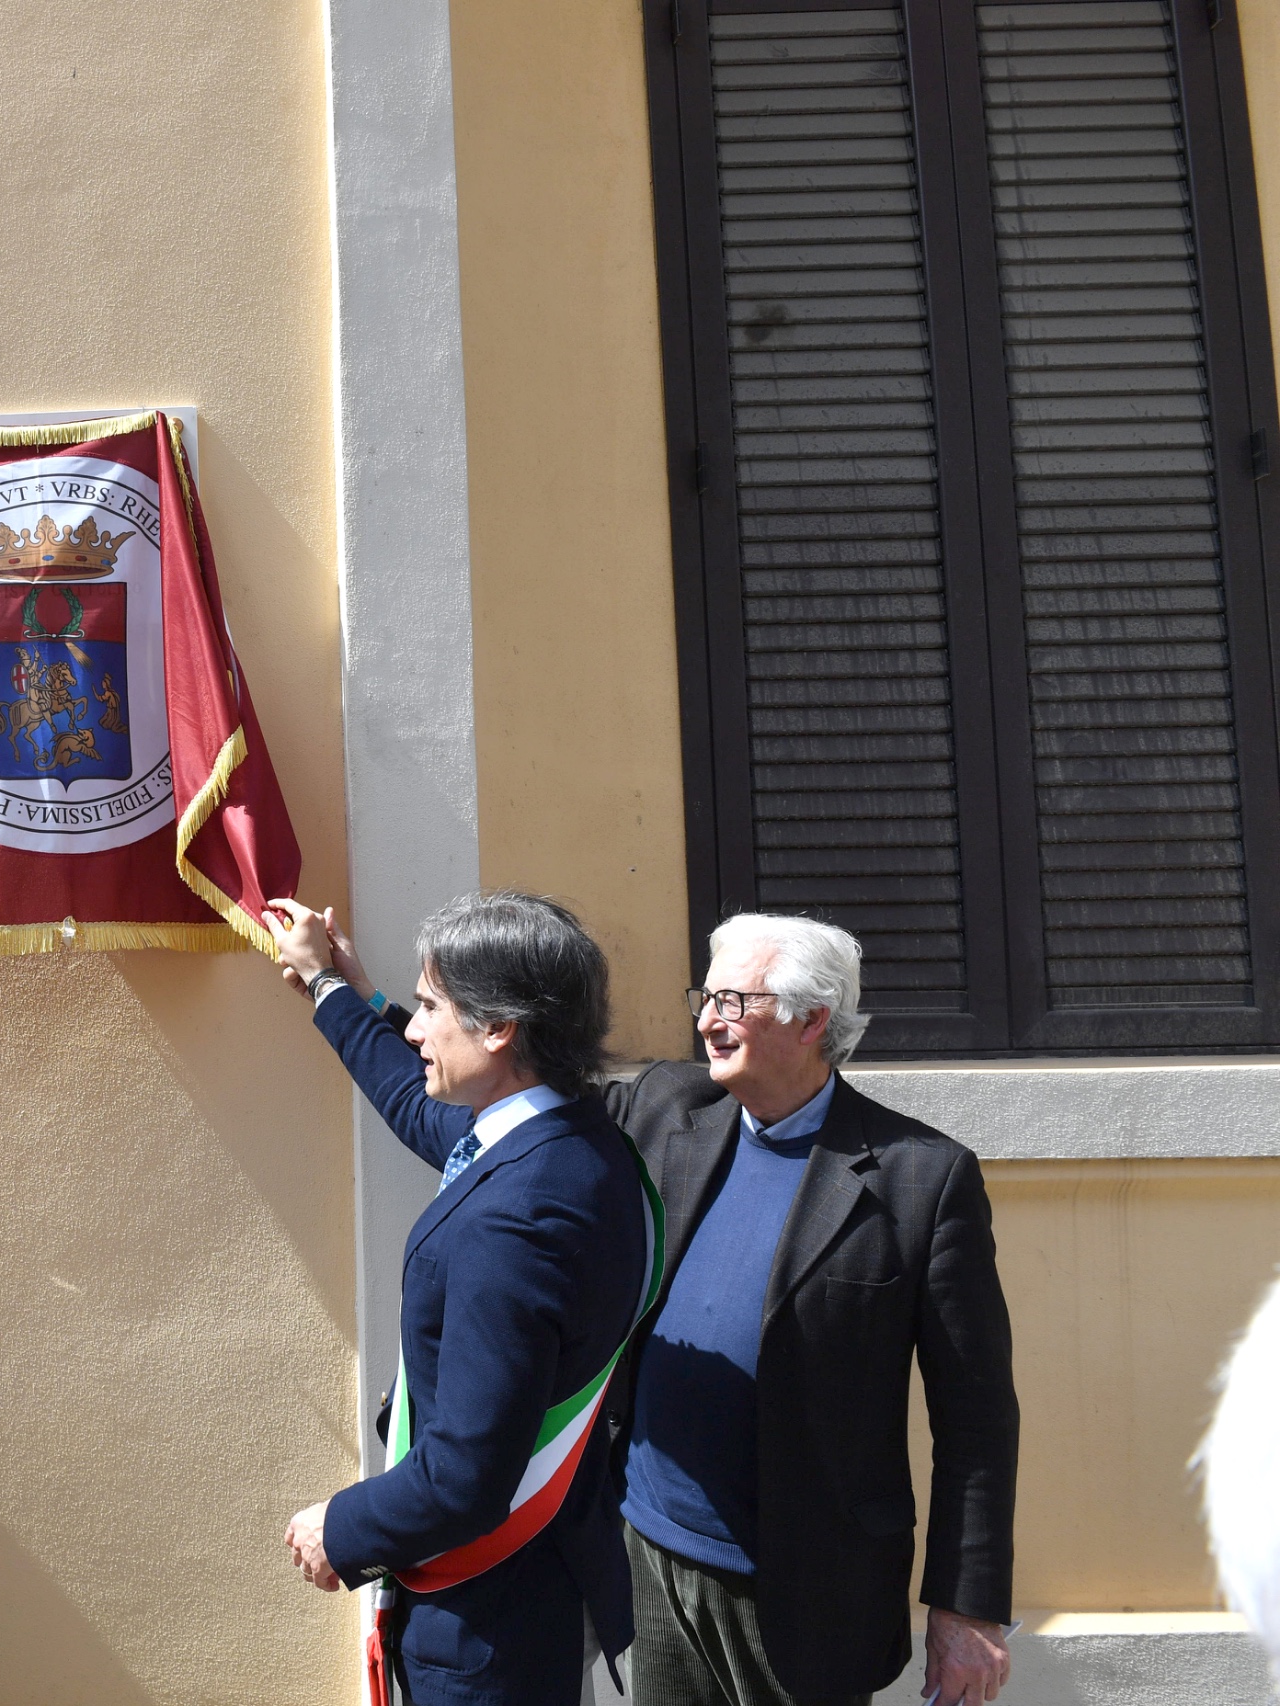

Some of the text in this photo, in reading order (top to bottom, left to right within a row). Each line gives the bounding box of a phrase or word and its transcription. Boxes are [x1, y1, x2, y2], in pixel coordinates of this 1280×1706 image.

[51, 481, 116, 506] VRBS:
[118, 495, 160, 538] RHE
[17, 784, 155, 825] FIDELISSIMA:
